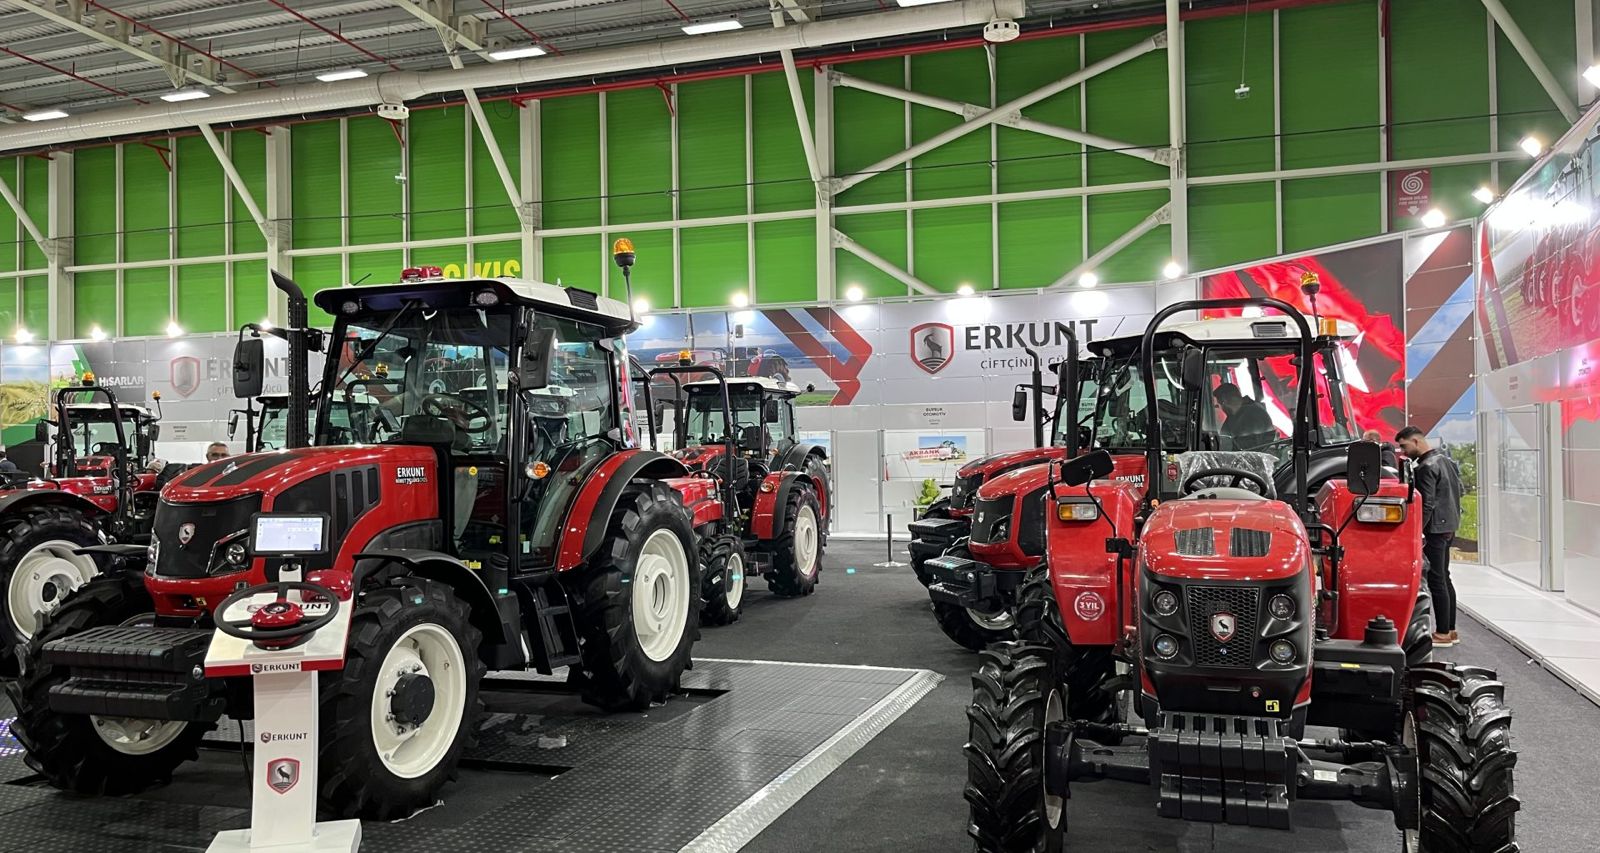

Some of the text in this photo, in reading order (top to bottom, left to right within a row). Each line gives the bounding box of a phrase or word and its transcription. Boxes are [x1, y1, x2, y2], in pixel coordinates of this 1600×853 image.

[965, 319, 1098, 350] ERKUNT
[207, 357, 289, 380] ERNT
[397, 467, 425, 478] ERKUNT
[1079, 601, 1085, 609] 3
[264, 663, 300, 672] ERKUNT
[272, 732, 308, 741] ERKUNT
